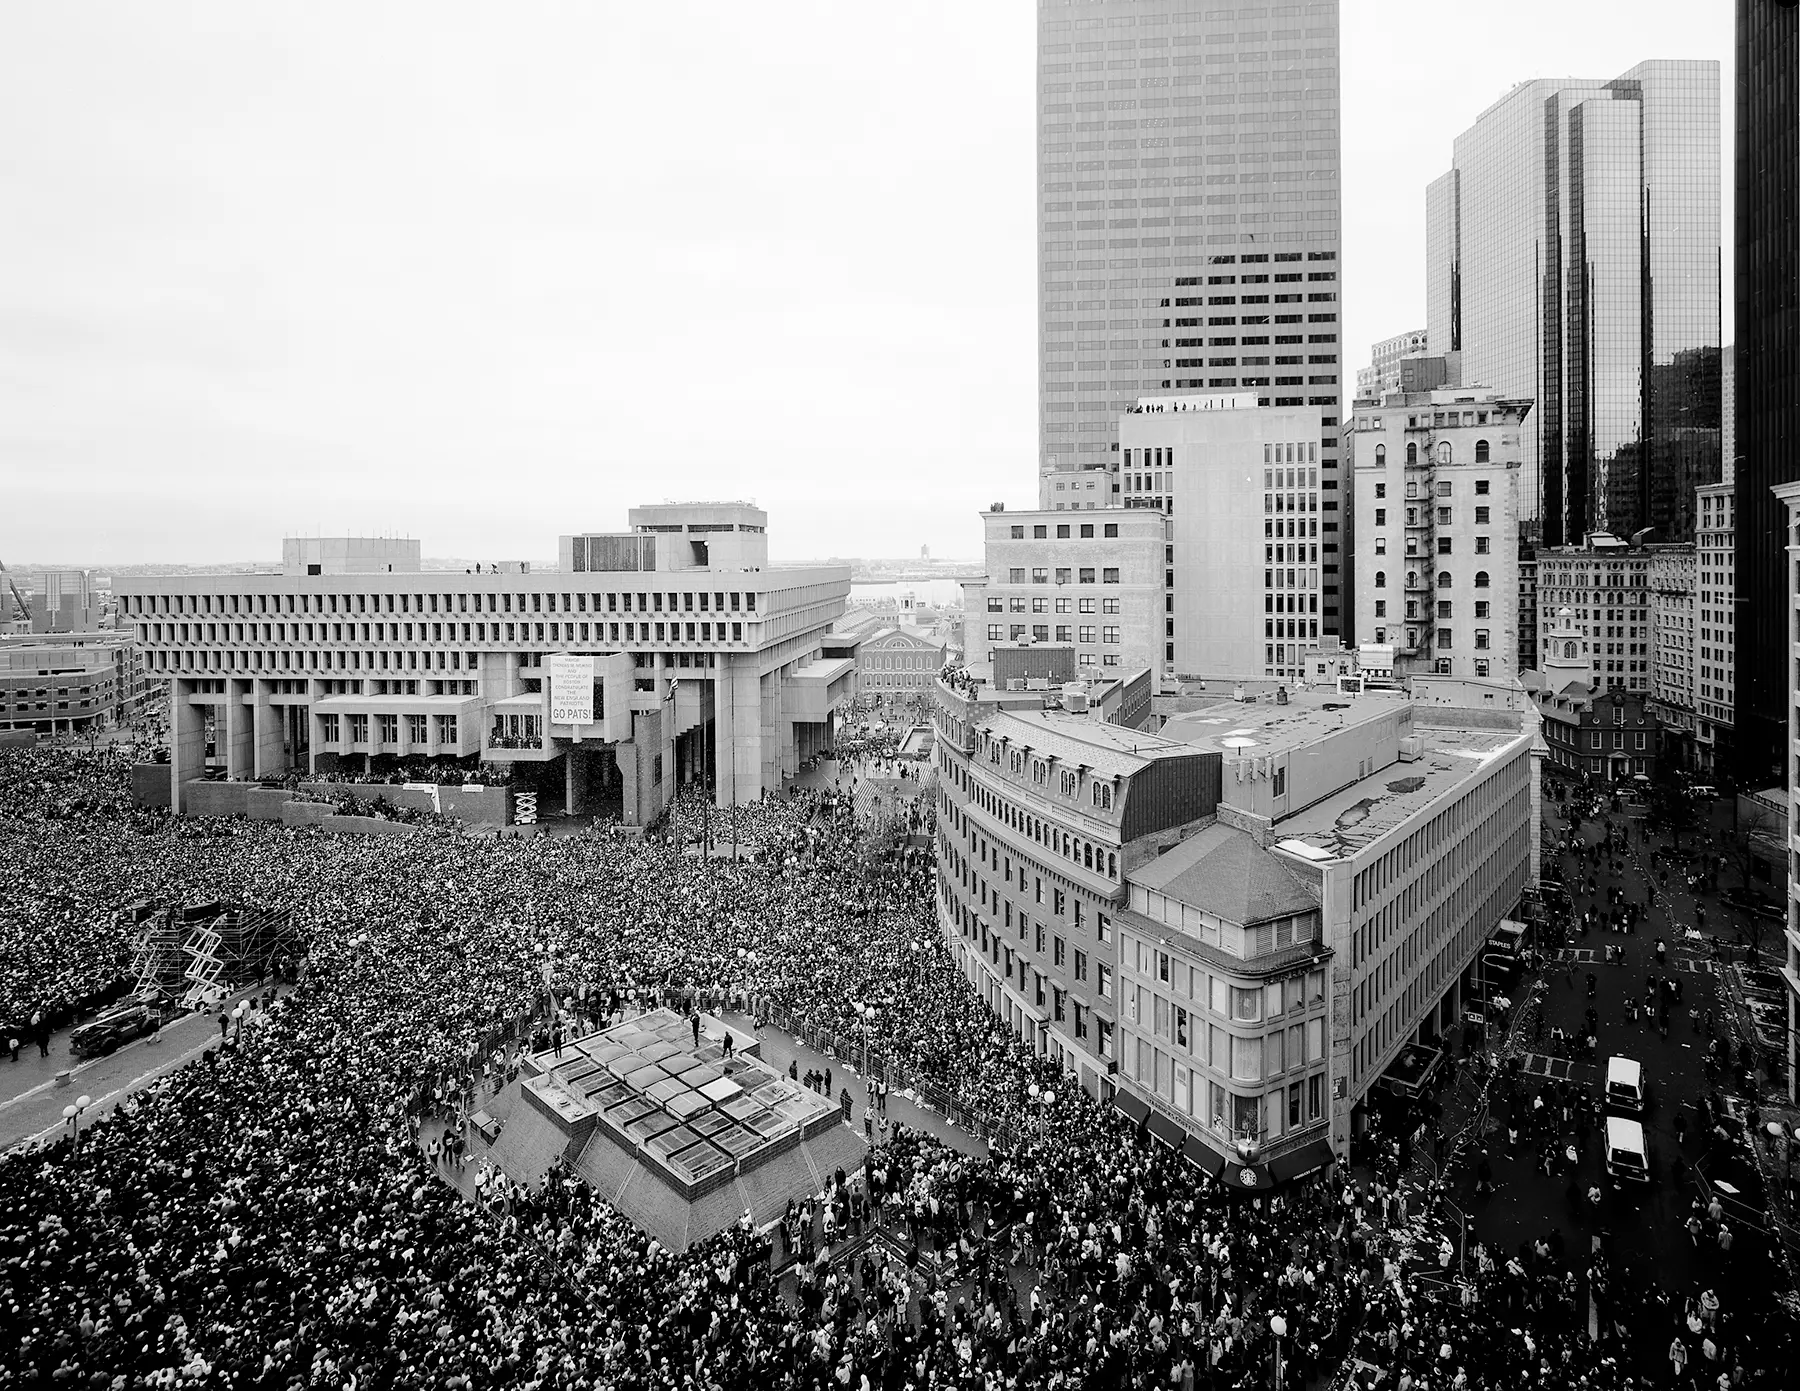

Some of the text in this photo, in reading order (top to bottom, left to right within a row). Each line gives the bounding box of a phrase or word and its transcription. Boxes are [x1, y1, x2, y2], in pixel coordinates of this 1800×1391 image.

[553, 708, 591, 719] GO PATS!
[1488, 939, 1511, 949] STAPLES
